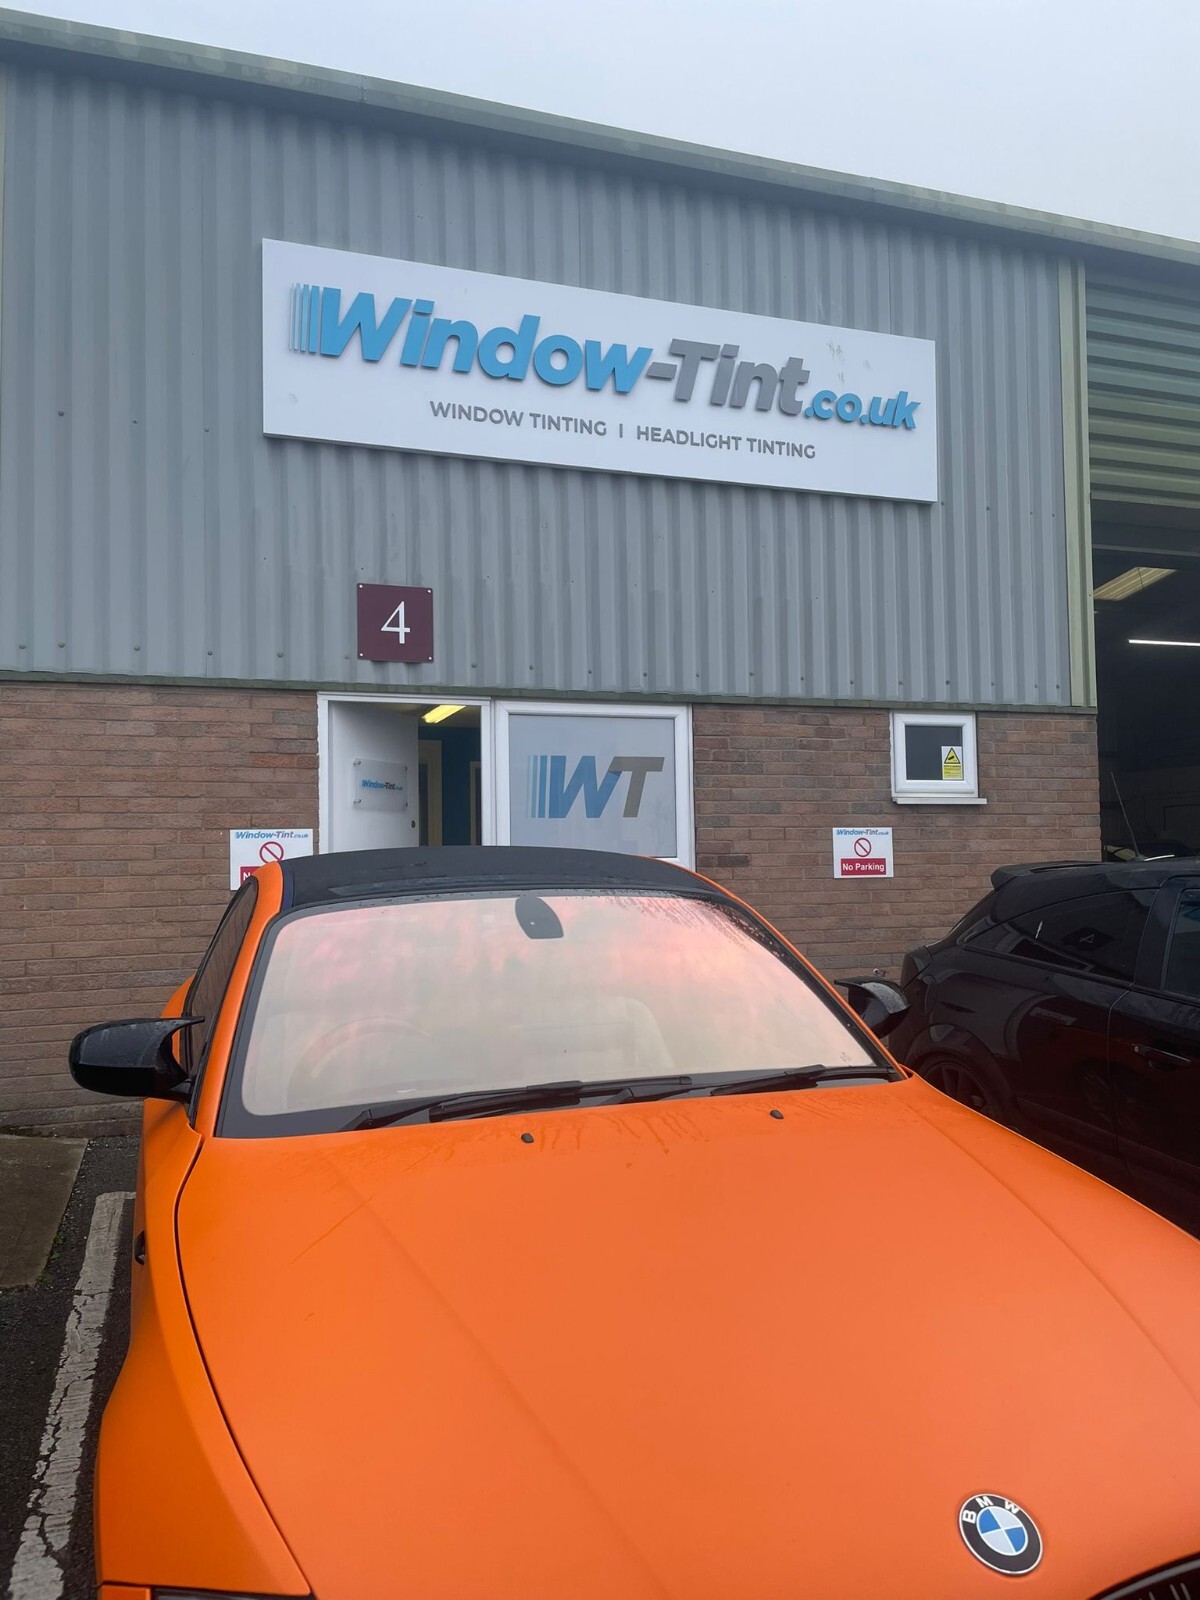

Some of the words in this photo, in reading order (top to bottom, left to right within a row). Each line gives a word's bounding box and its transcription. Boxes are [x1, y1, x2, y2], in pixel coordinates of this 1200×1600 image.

[319, 283, 921, 430] Window-Tint.co.uk
[430, 400, 524, 427] WINDOW
[529, 412, 607, 437] TINTING
[636, 425, 742, 451] HEADLIGHT
[747, 437, 816, 459] TINTING
[381, 601, 410, 644] 4
[548, 755, 665, 819] WT
[842, 863, 853, 871] No
[855, 863, 885, 872] Parking
[962, 1496, 1020, 1524] BMW
